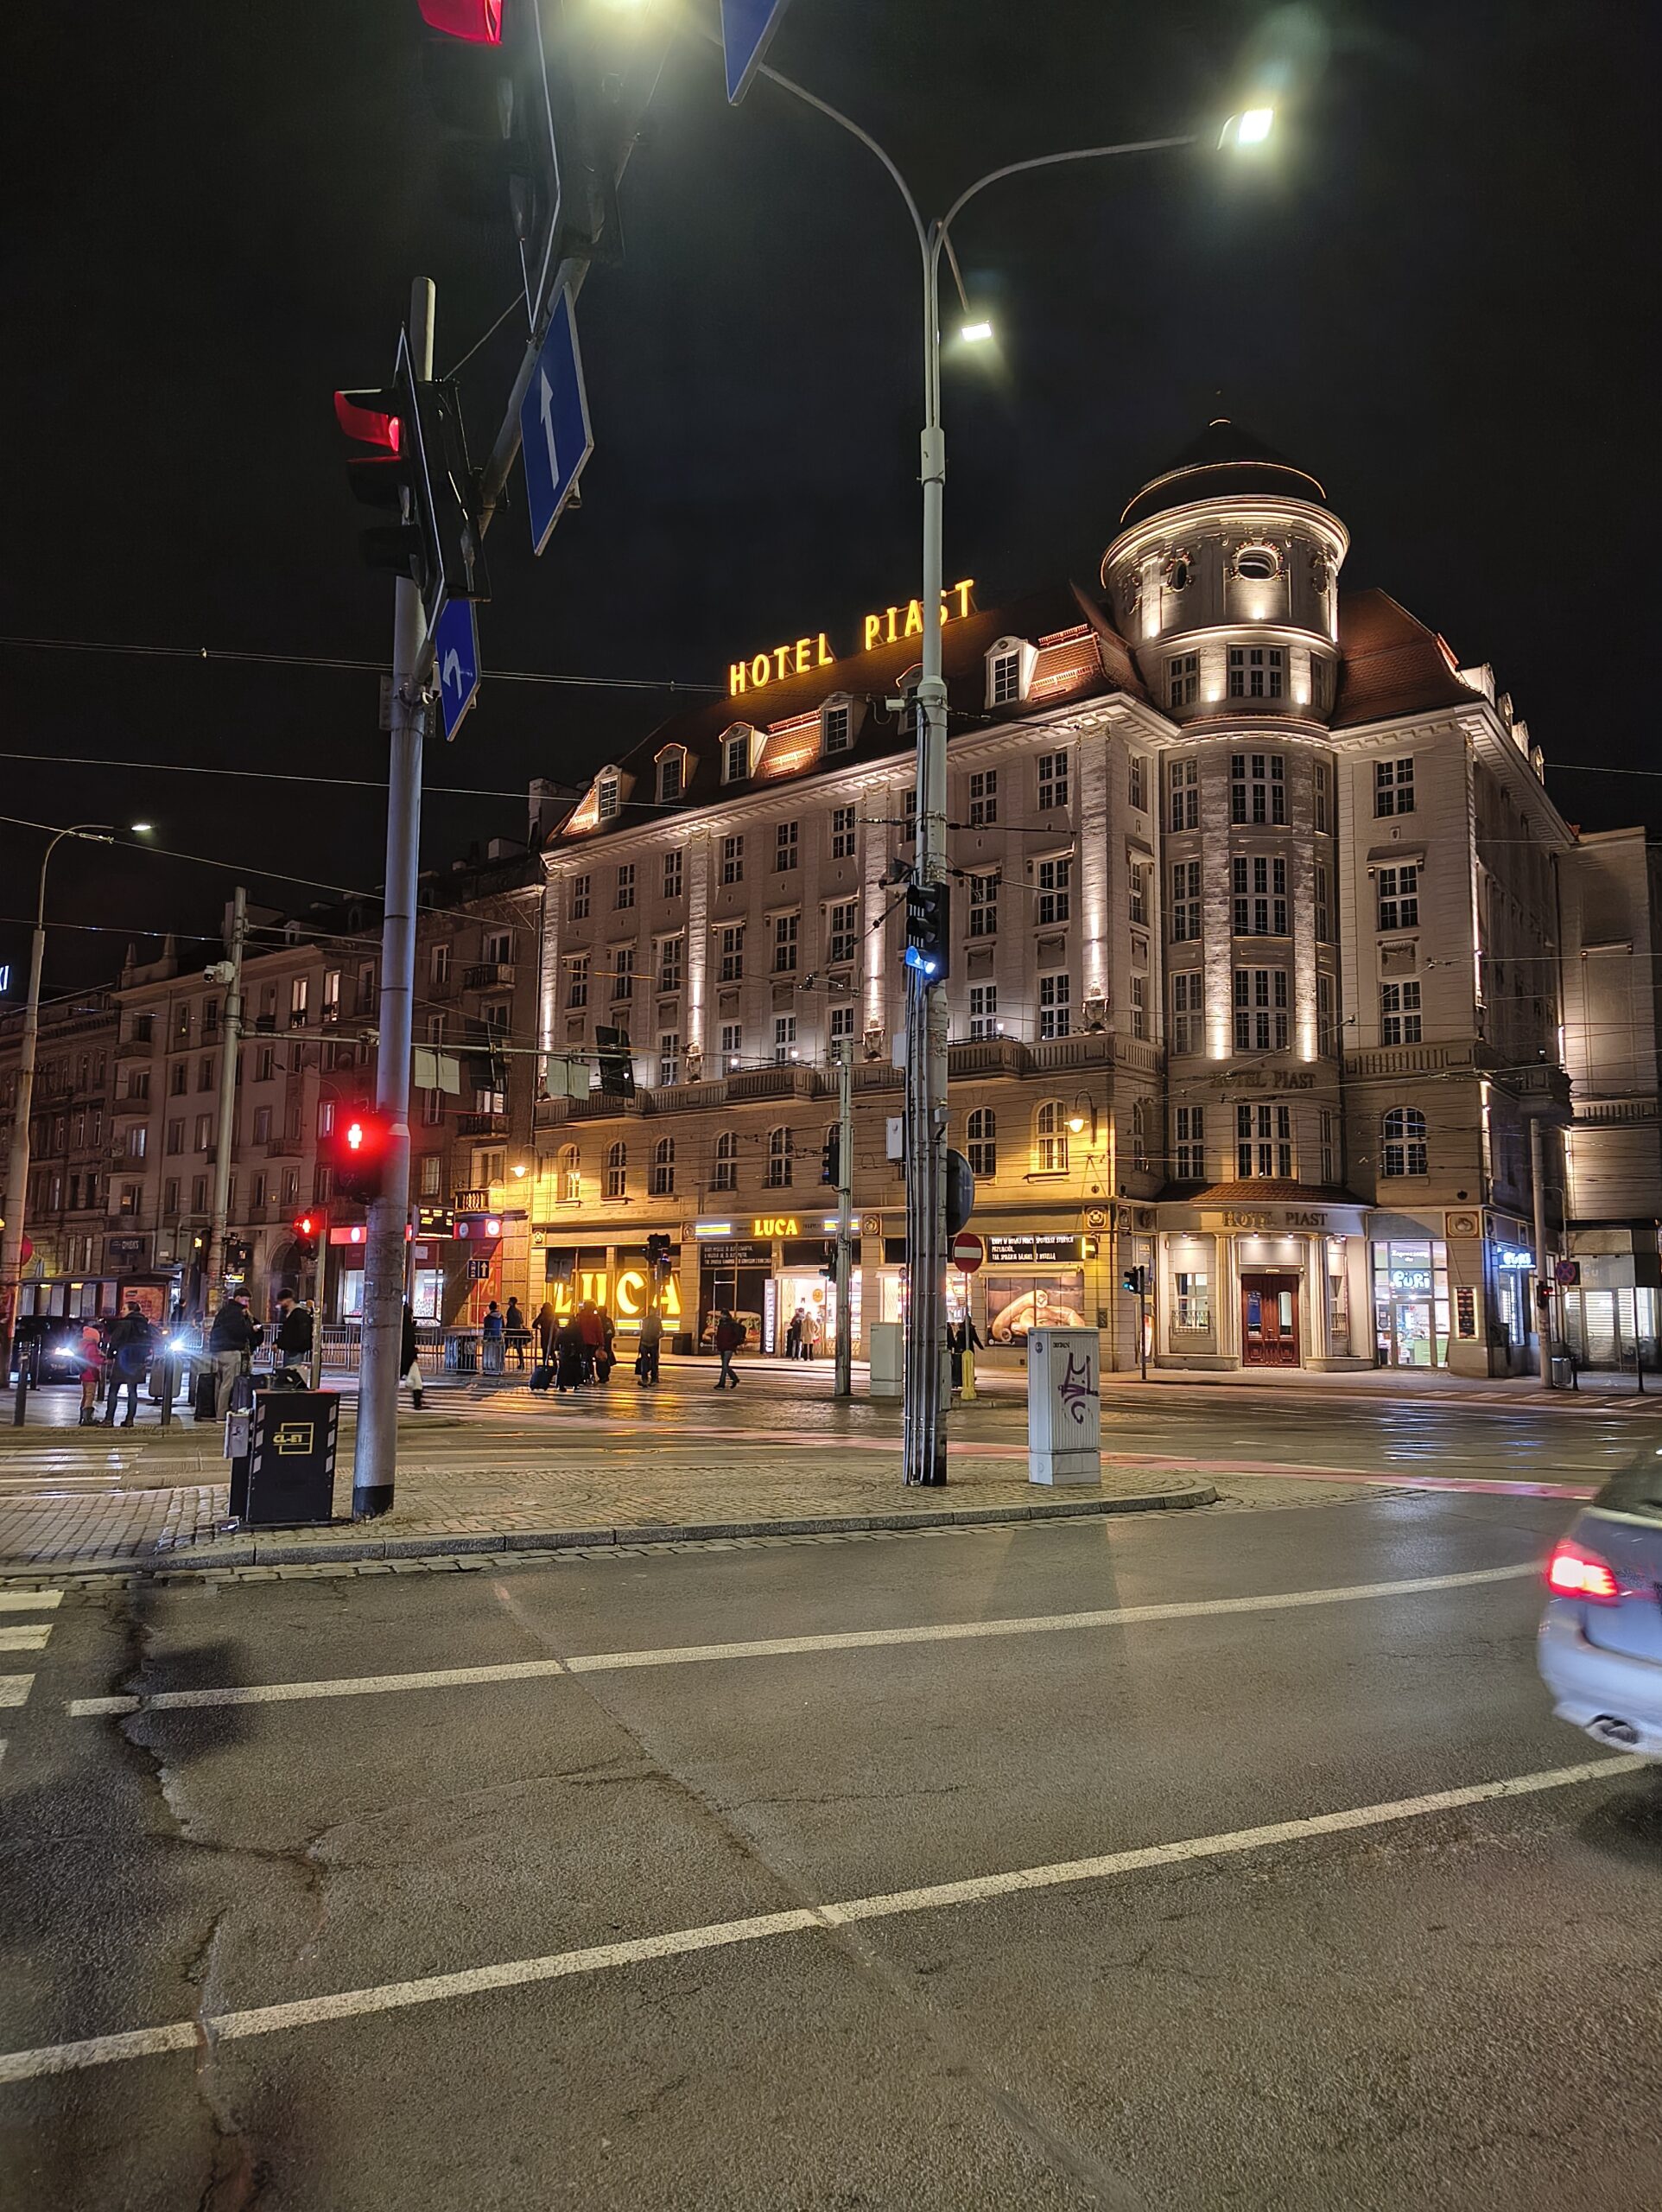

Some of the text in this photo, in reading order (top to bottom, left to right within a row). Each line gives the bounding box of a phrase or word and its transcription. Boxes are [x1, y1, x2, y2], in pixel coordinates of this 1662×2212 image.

[729, 632, 834, 696] HOTEL
[1272, 1070, 1316, 1089] PIAST
[754, 1217, 798, 1236] LUCA
[1222, 1211, 1329, 1227] HOTEL PIAST
[554, 1271, 682, 1315] LUCA
